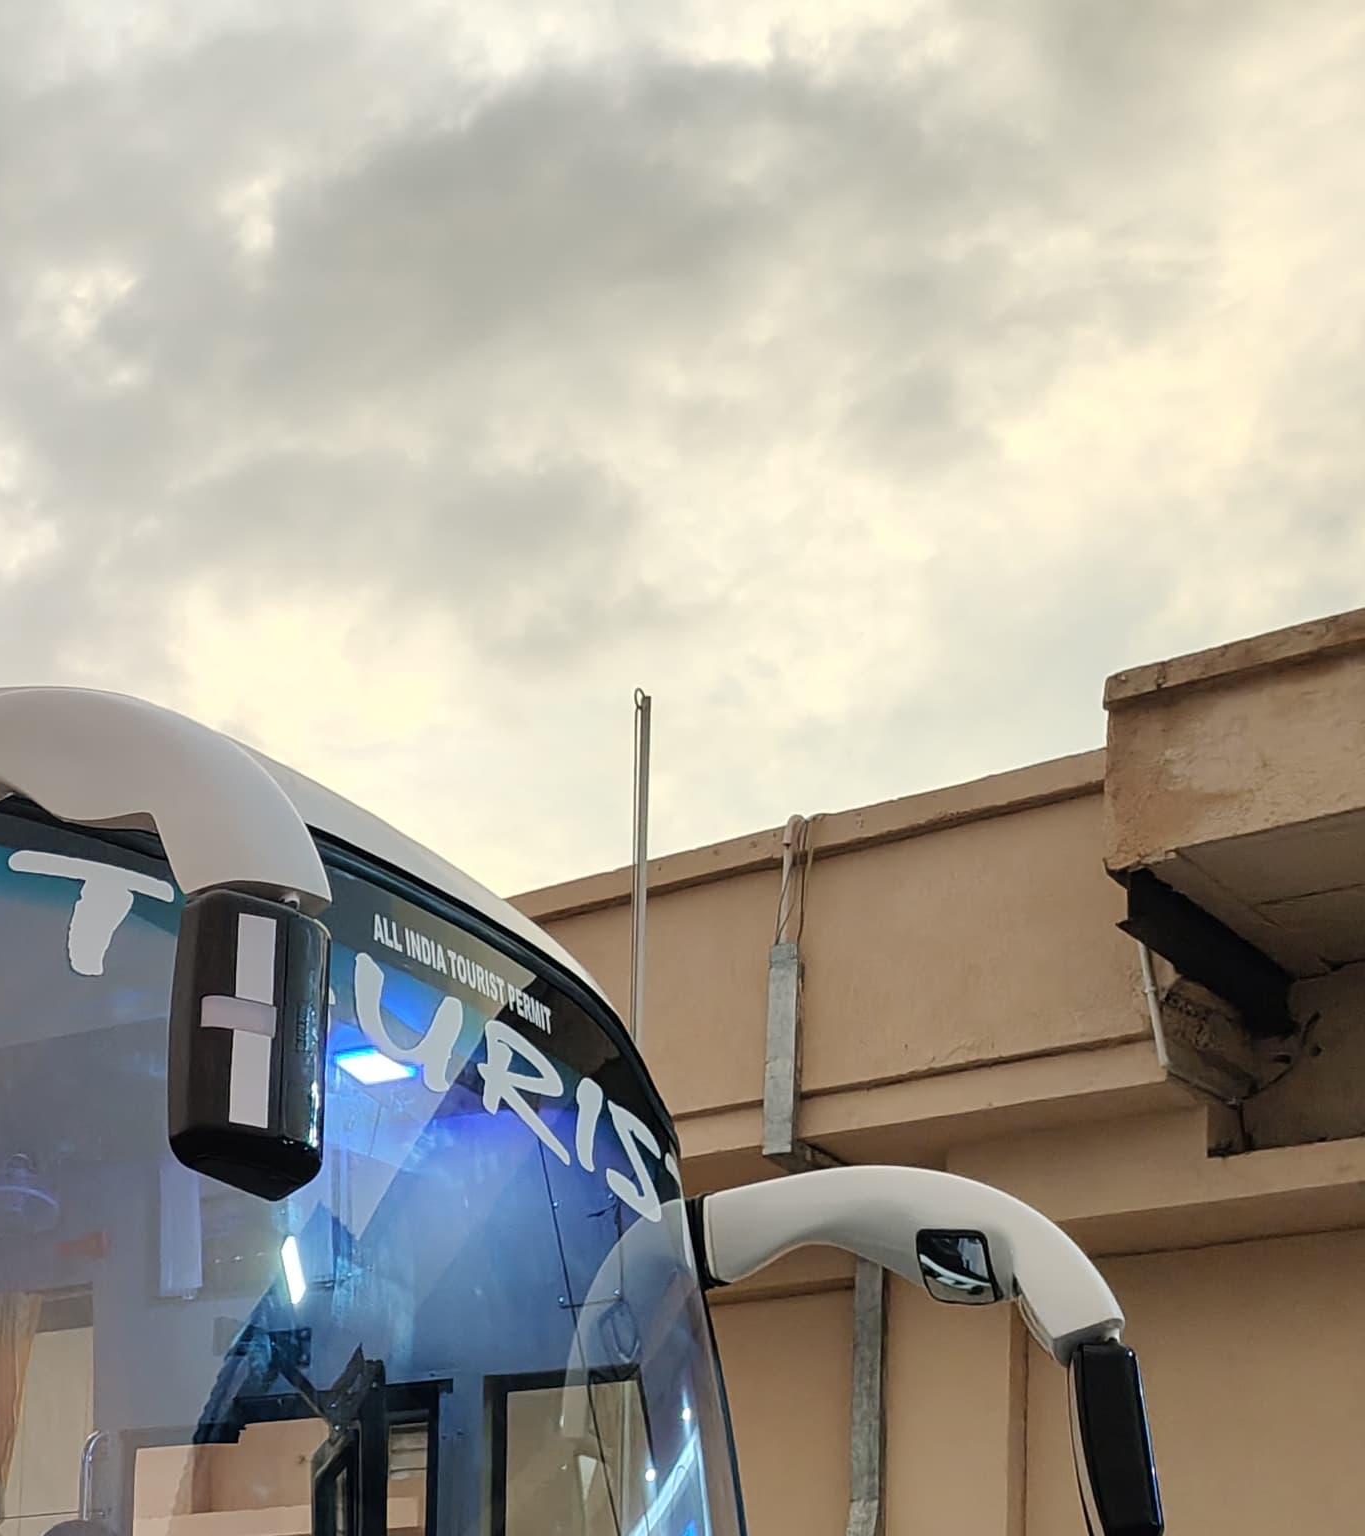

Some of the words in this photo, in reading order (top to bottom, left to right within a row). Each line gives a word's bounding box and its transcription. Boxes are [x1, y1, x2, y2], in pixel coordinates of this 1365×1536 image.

[7, 848, 682, 1222] TURIS
[373, 913, 403, 952] ALL
[404, 927, 448, 975] INDIA
[447, 948, 506, 1006] TOURIST
[507, 983, 552, 1034] PERMIT
